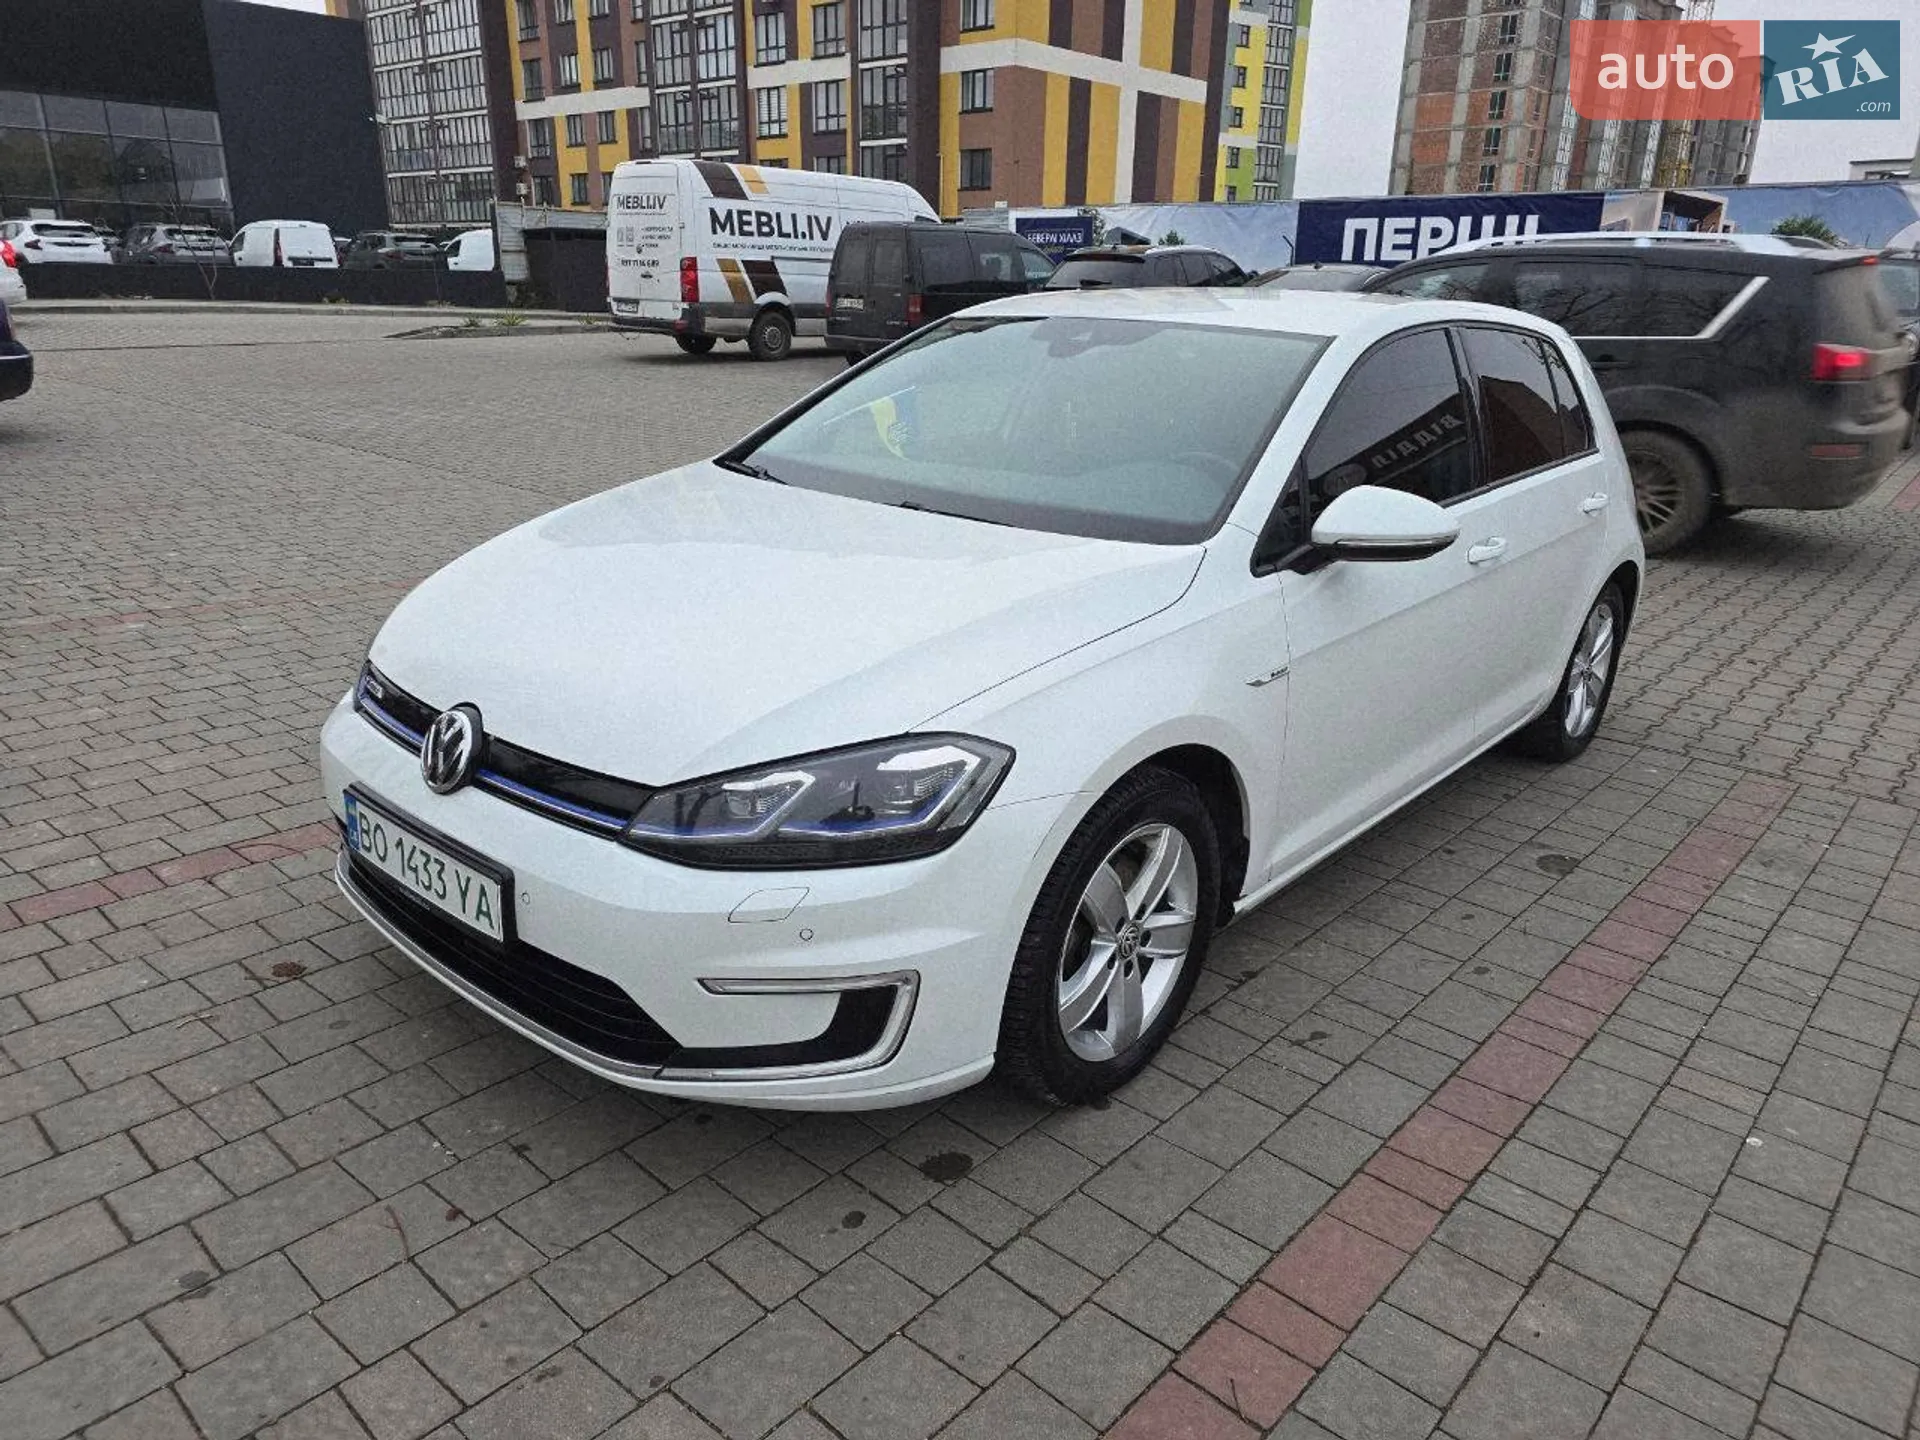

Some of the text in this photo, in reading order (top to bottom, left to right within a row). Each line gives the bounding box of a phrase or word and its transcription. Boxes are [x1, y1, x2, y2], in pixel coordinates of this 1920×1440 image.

[708, 207, 832, 241] MEBLI.IV
[359, 811, 494, 930] BO 1433 YA
